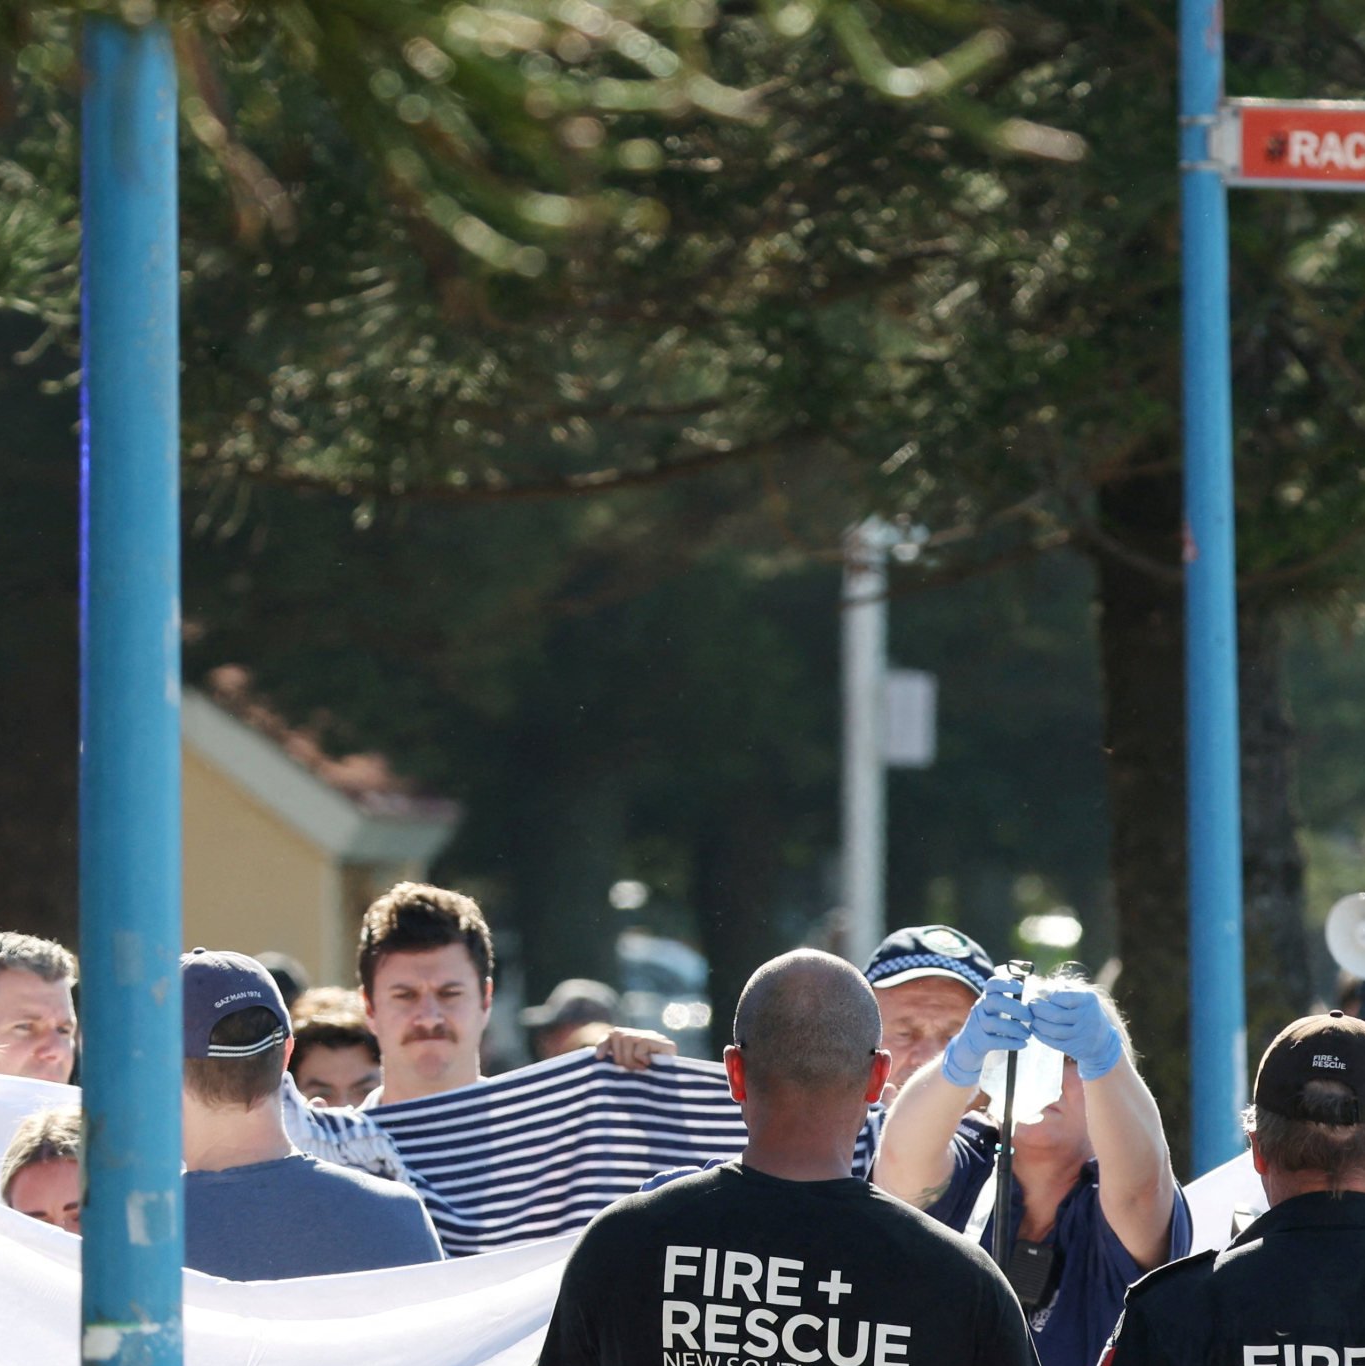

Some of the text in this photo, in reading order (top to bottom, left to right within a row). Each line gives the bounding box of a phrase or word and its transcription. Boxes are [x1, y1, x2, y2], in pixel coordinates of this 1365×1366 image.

[1313, 1054, 1333, 1062] FIRE
[1312, 1060, 1346, 1070] RESCUE
[663, 1245, 804, 1307] FIRE
